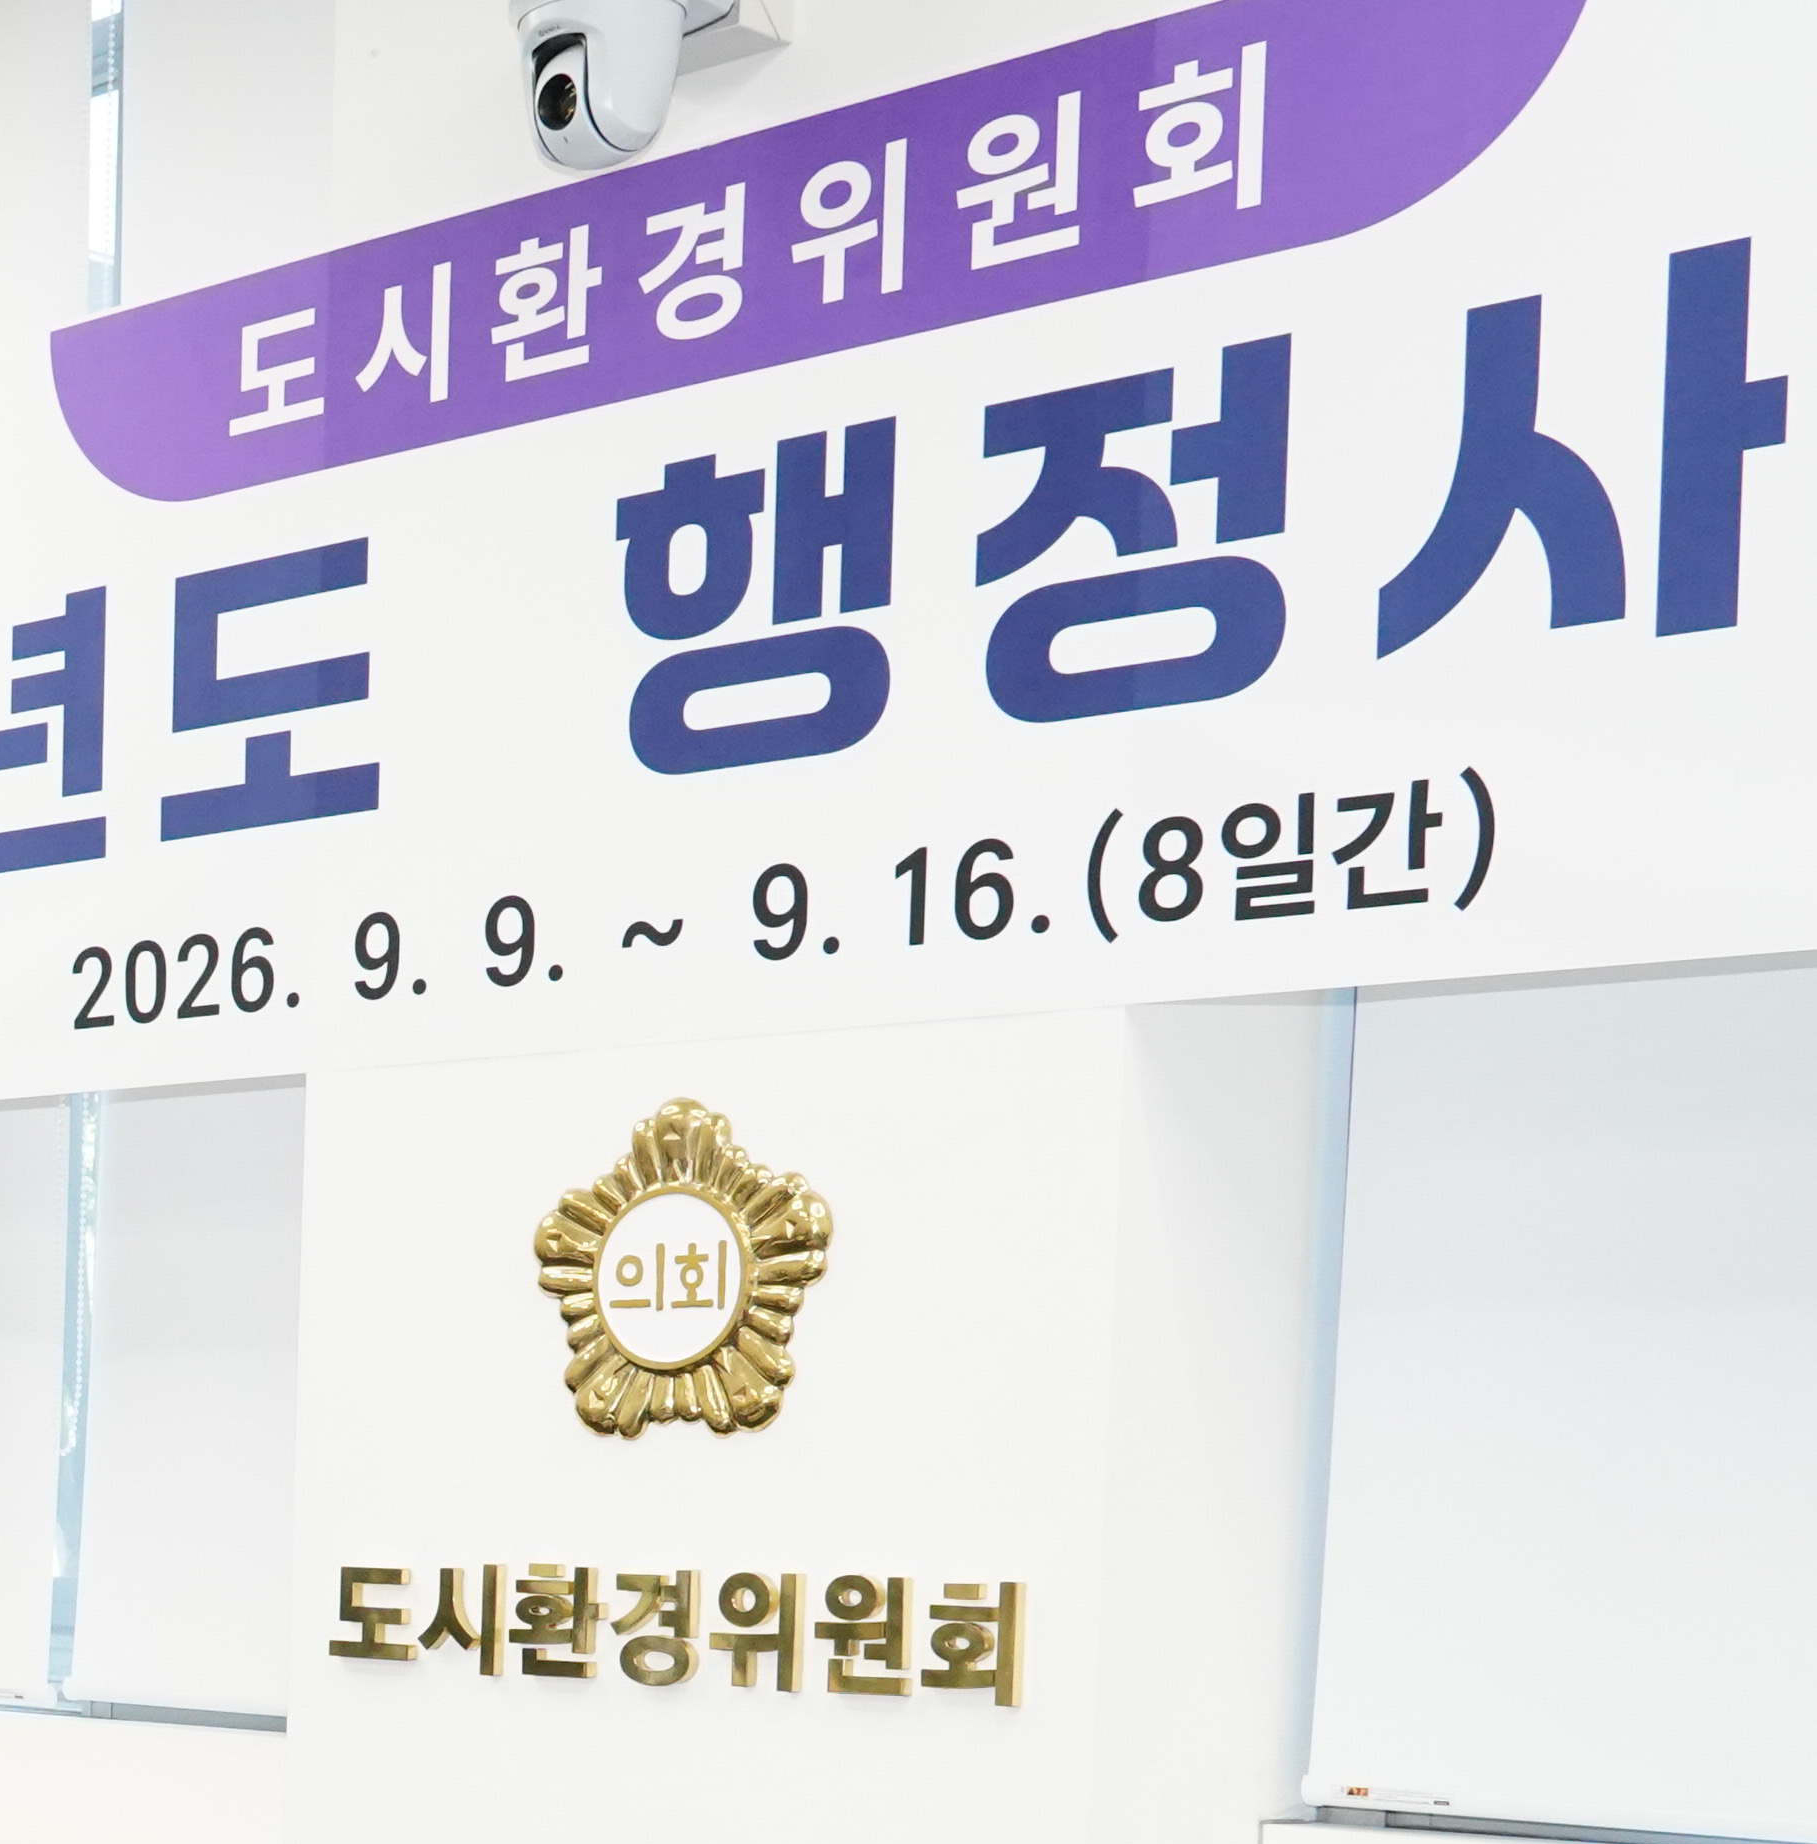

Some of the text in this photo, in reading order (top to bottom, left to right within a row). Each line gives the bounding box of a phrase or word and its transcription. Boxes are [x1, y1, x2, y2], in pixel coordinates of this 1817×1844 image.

[228, 40, 1268, 438] 도시환경위원회
[613, 237, 1787, 776] 행정사
[71, 926, 301, 1030] 2026.
[353, 911, 428, 1001] 9.
[485, 895, 564, 987] 9.
[608, 1240, 728, 1311] 의회
[328, 1561, 1028, 1709] 도시환경위원회
